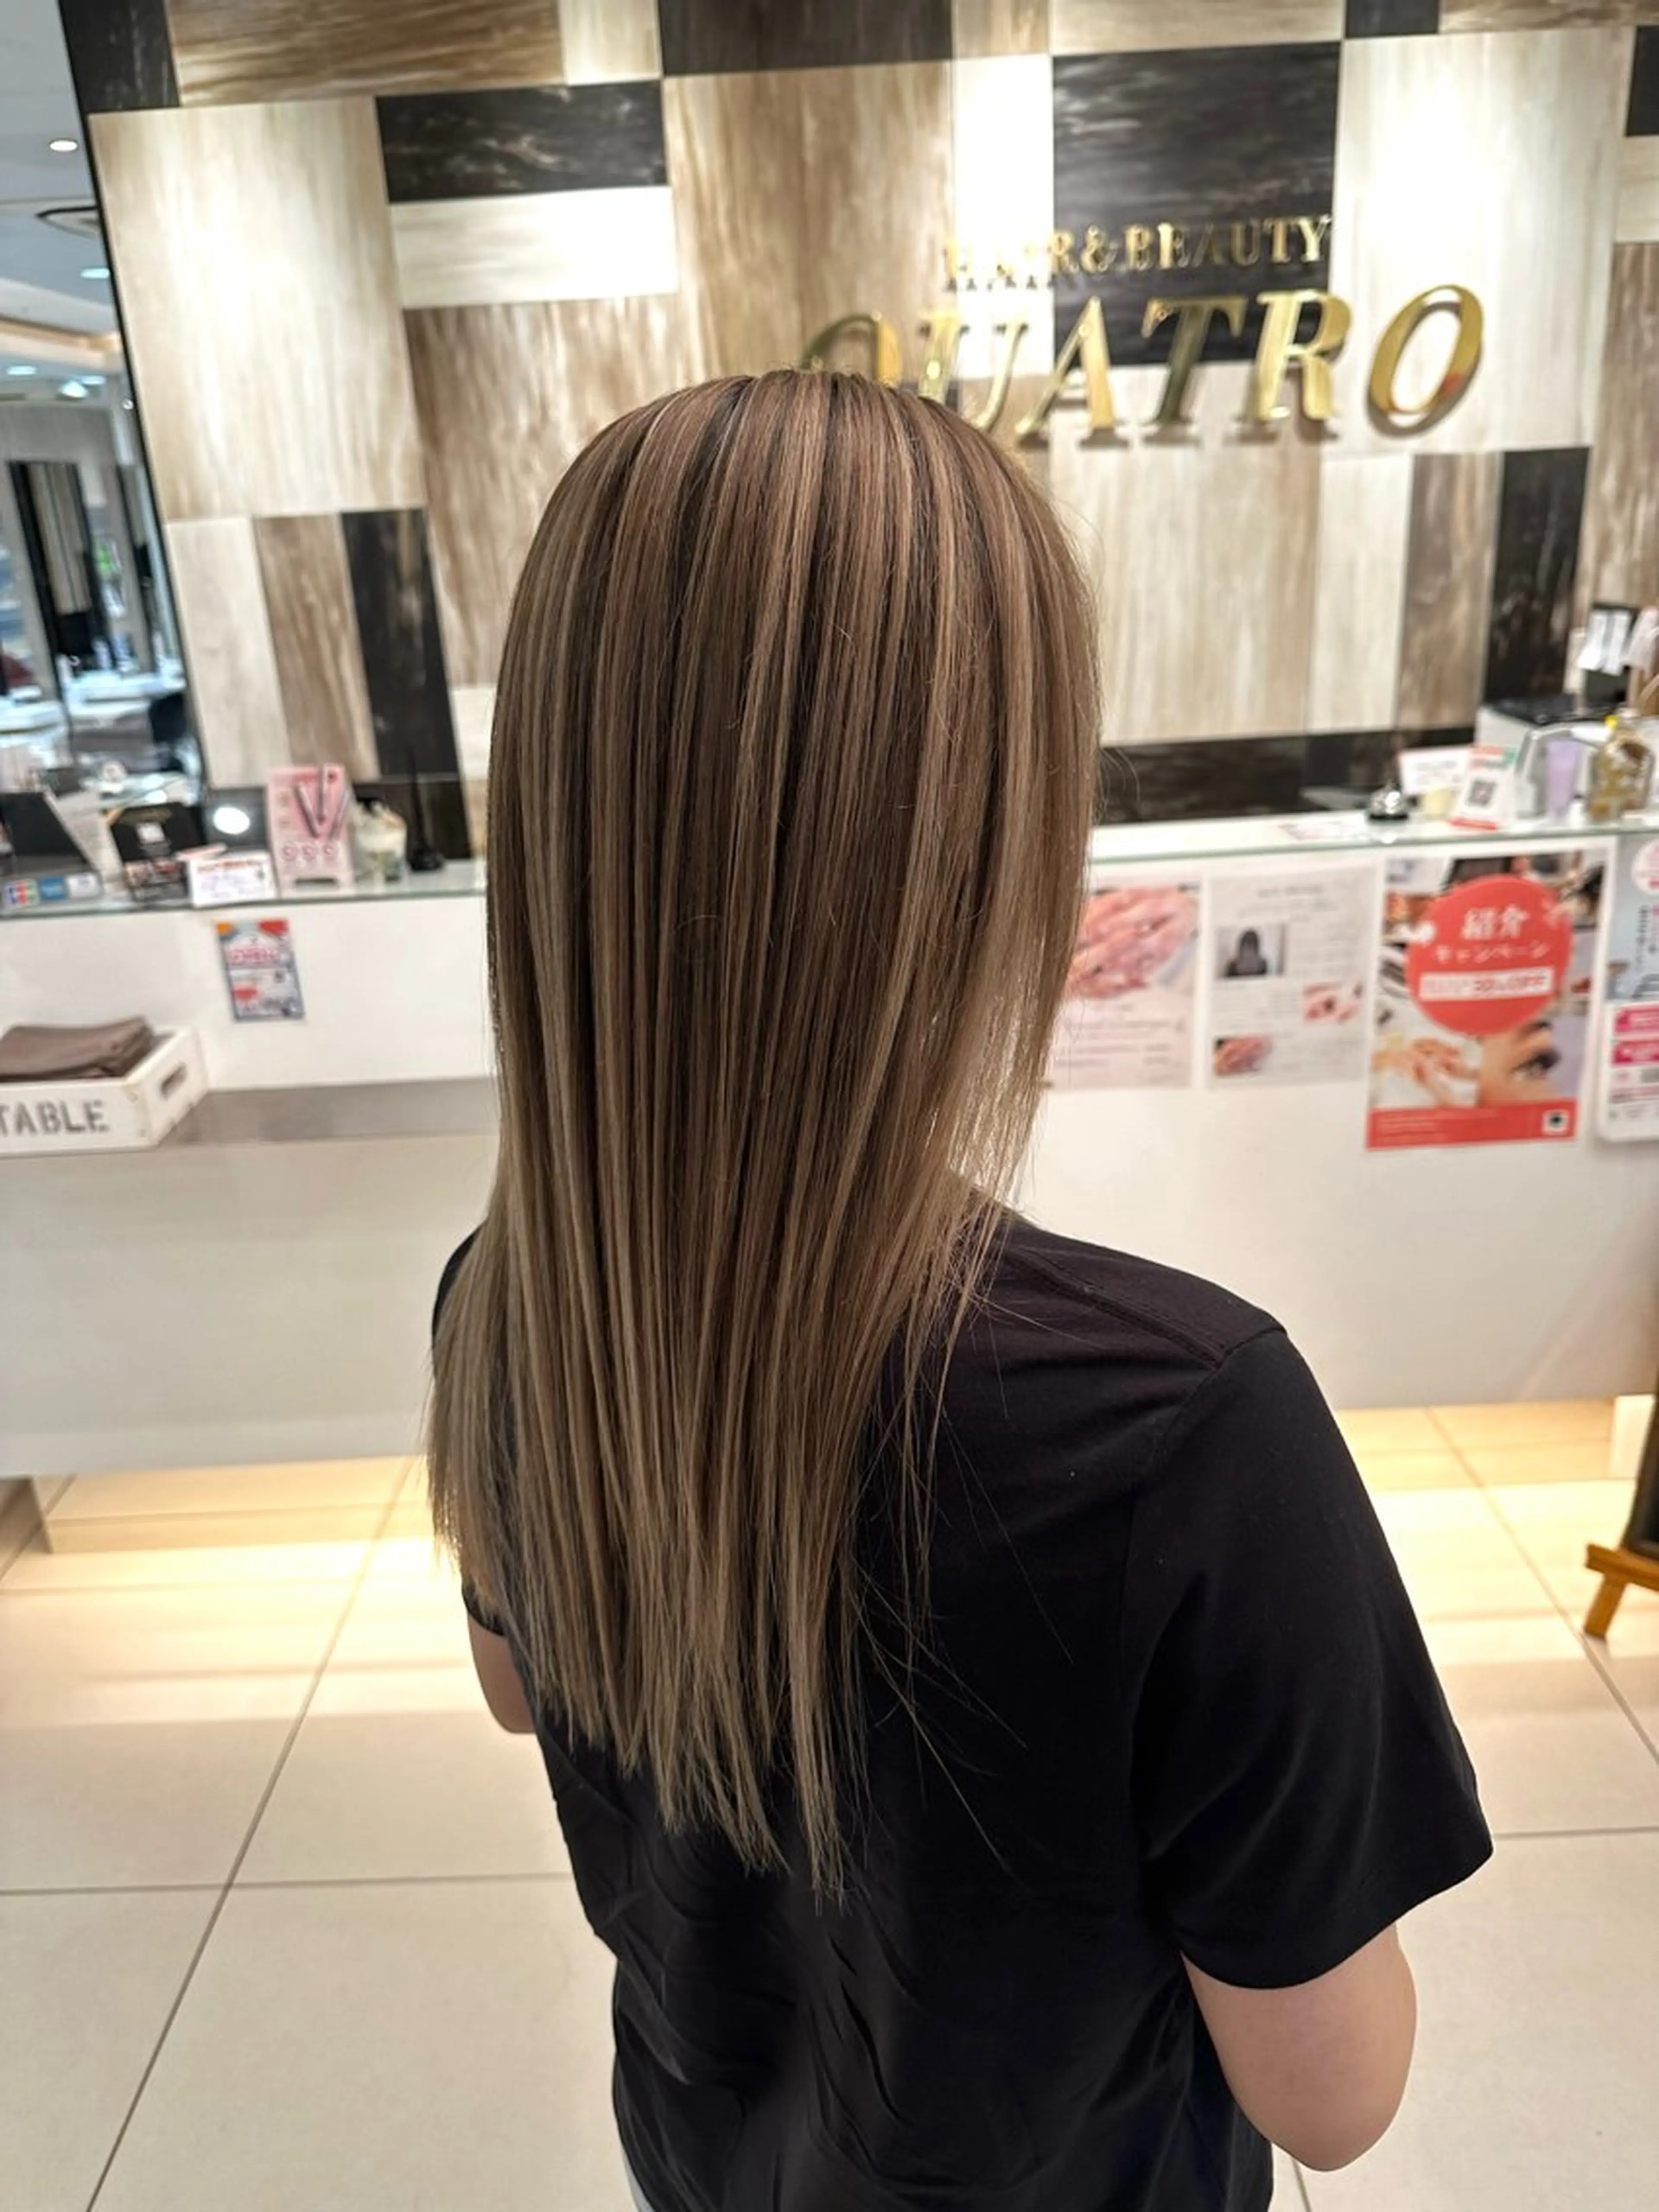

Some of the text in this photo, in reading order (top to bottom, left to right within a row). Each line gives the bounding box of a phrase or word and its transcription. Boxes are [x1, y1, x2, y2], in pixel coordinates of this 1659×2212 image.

[944, 214, 1332, 279] HR&BEAUTY
[1461, 904, 1530, 939] 紹介
[1435, 941, 1549, 964] キャンペーン
[0, 1100, 110, 1137] TABLE
